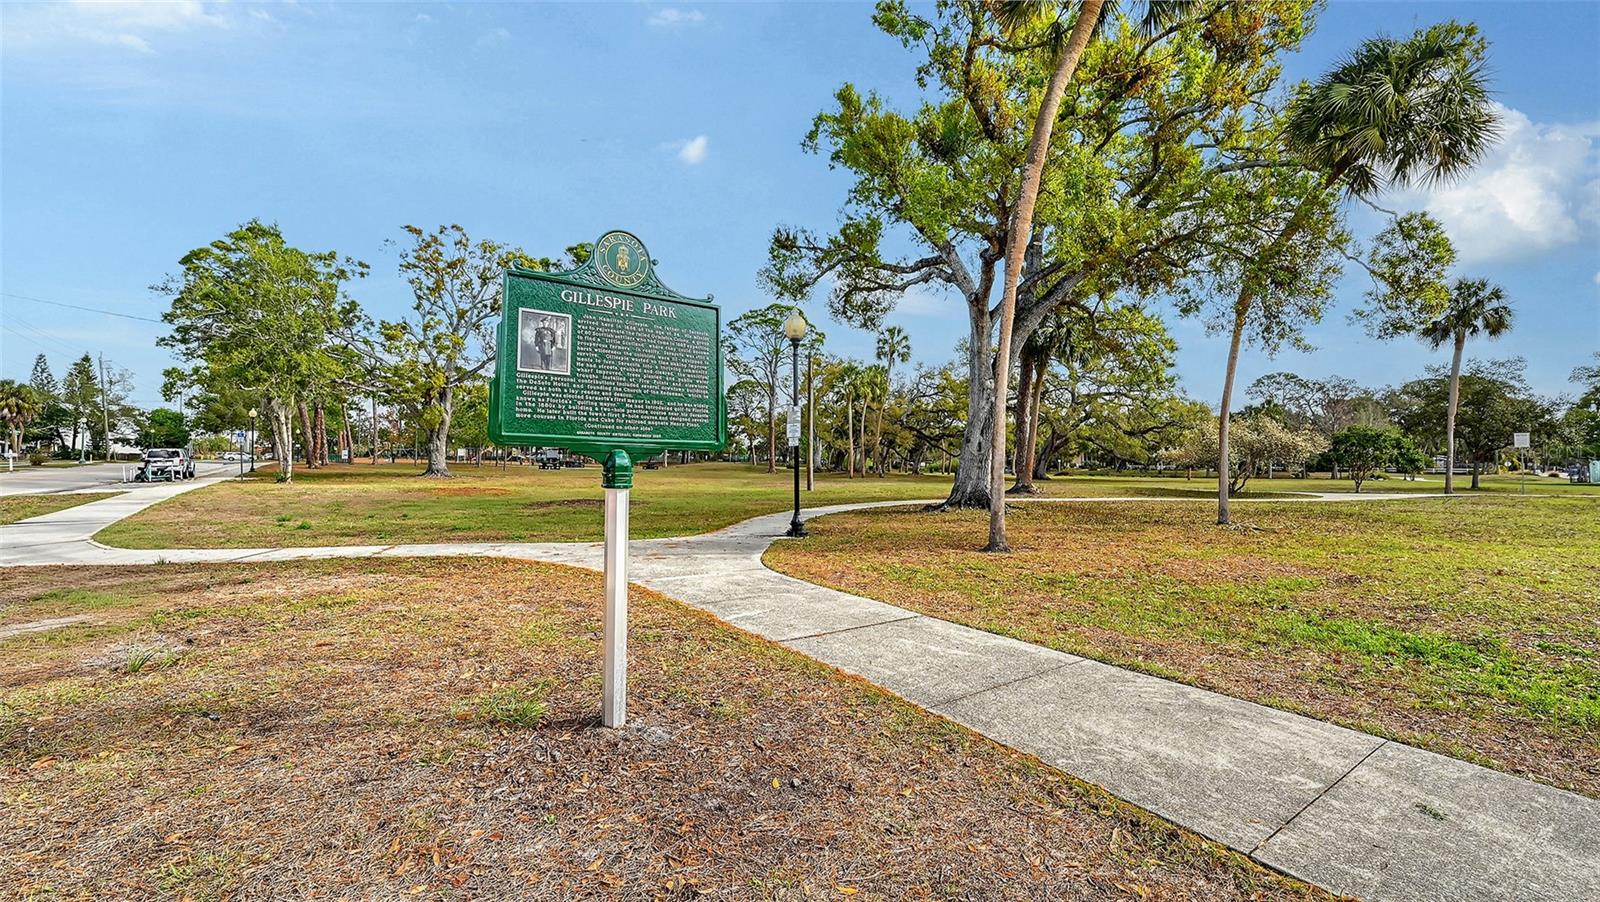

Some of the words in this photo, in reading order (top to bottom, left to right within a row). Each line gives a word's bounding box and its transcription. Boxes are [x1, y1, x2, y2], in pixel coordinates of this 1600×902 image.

[600, 235, 646, 262] SARASOTA
[602, 264, 643, 284] COUNTY
[561, 290, 634, 312] GILLESPIE
[643, 303, 677, 318] PARK
